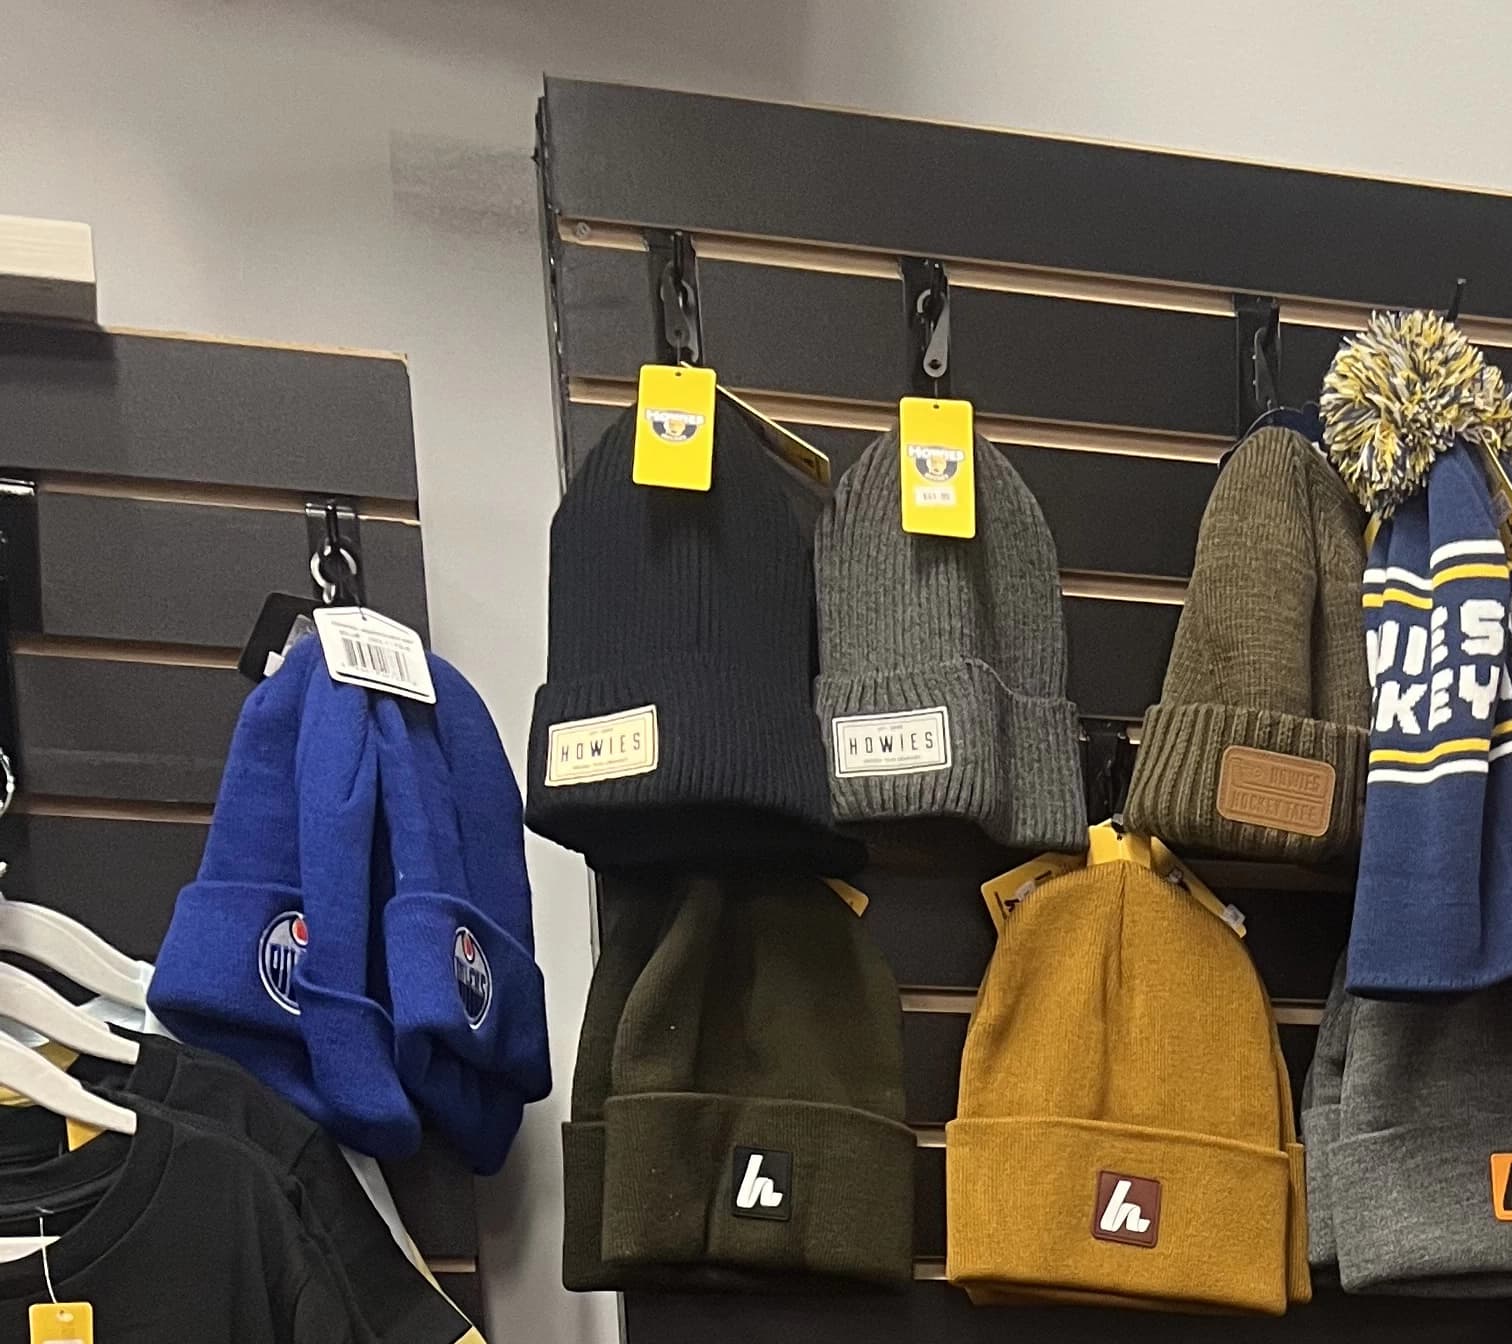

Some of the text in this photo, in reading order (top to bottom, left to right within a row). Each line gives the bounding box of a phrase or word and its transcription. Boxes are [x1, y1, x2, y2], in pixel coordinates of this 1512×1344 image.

[561, 731, 642, 764] HOWIES
[848, 731, 935, 757] HOWIES
[1270, 766, 1321, 793] HOWIES
